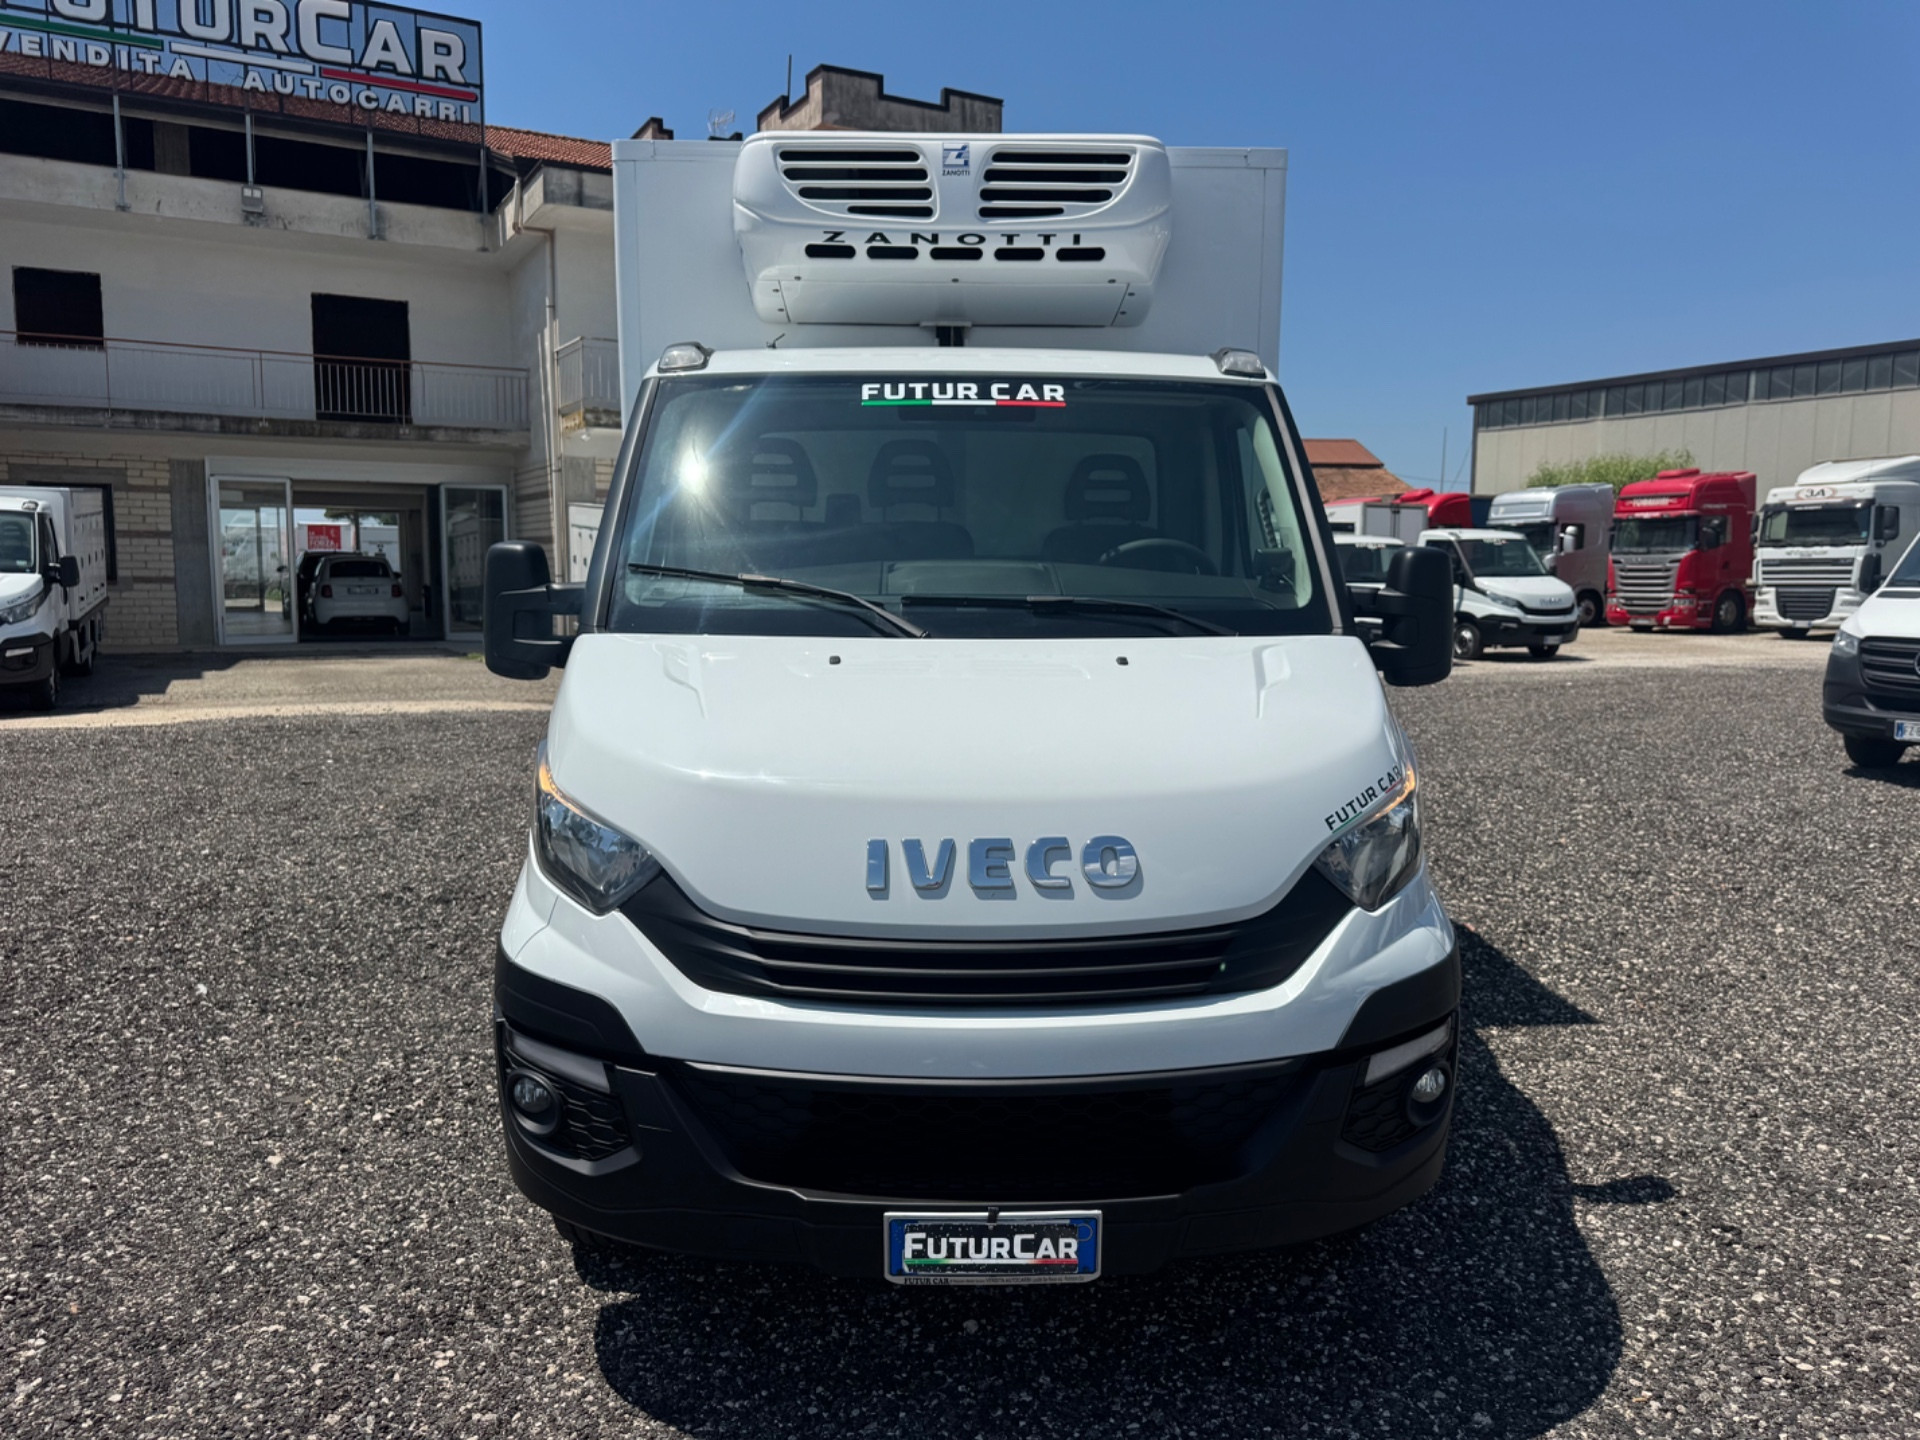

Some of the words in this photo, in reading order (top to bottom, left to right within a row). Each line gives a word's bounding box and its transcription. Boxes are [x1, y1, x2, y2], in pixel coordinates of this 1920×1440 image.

[243, 70, 470, 124] AUTOCARRI
[823, 231, 1081, 246] ZANOTTI
[861, 383, 979, 400] FUTUR
[990, 383, 1065, 401] CAR
[1324, 786, 1378, 831] FUTUR
[1377, 765, 1403, 792] CAR
[865, 836, 1138, 891] IVECO
[904, 1277, 931, 1285] FUTUR
[932, 1277, 950, 1285] CAR
